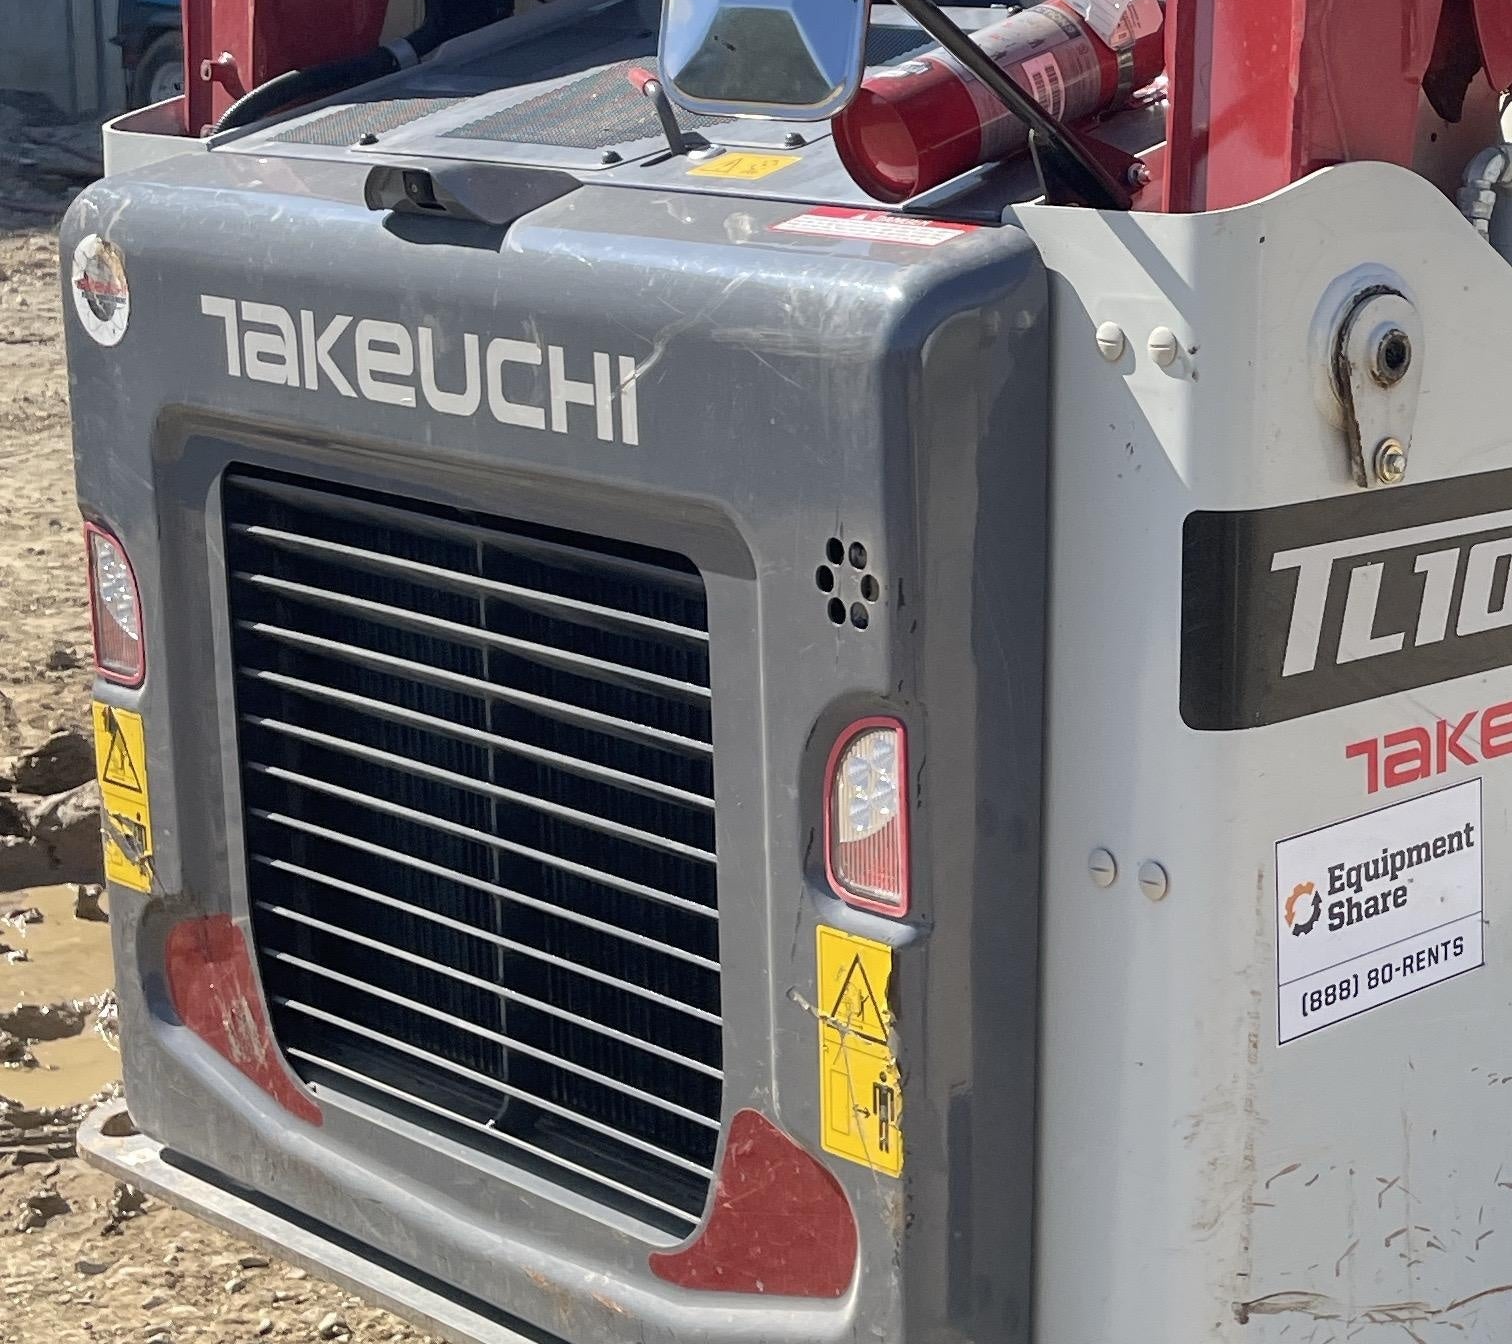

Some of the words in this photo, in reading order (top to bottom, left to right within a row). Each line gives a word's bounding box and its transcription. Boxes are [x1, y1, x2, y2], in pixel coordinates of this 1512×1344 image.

[201, 294, 640, 446] TAKEUCHI
[1327, 822, 1475, 896] Equipment
[1327, 885, 1408, 932] Share
[1302, 973, 1359, 1017] (888)
[1367, 935, 1464, 990] 80-RENTS
